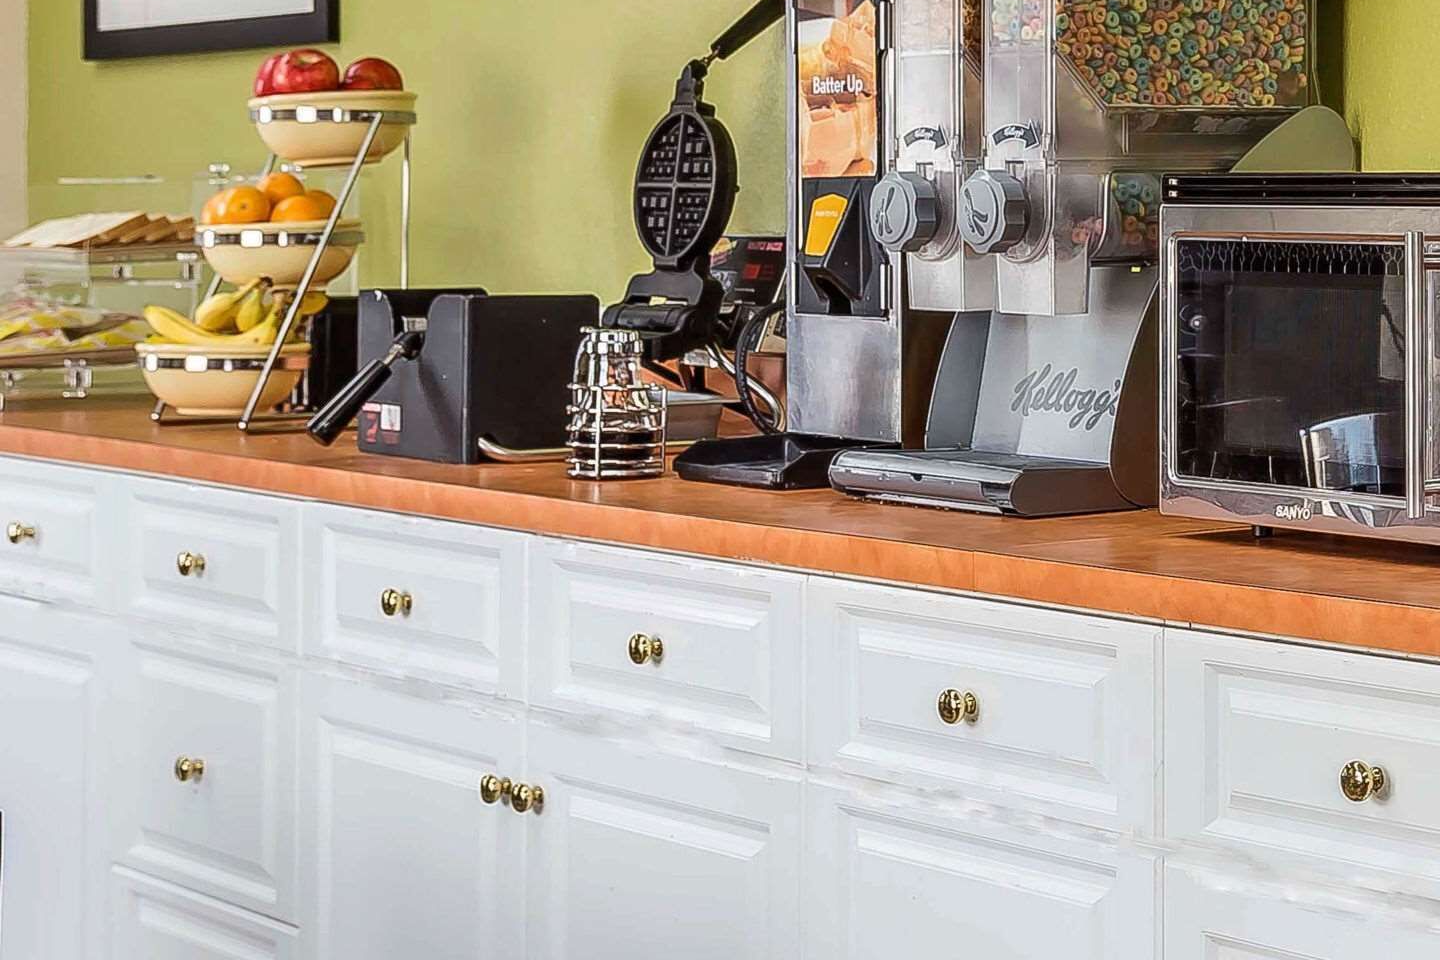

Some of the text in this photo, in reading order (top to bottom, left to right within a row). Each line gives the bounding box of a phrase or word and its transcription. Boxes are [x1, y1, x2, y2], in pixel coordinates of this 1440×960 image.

[812, 74, 864, 96] Batter Up
[1010, 363, 1121, 431] Kellogg's
[1275, 504, 1312, 521] SANYO
